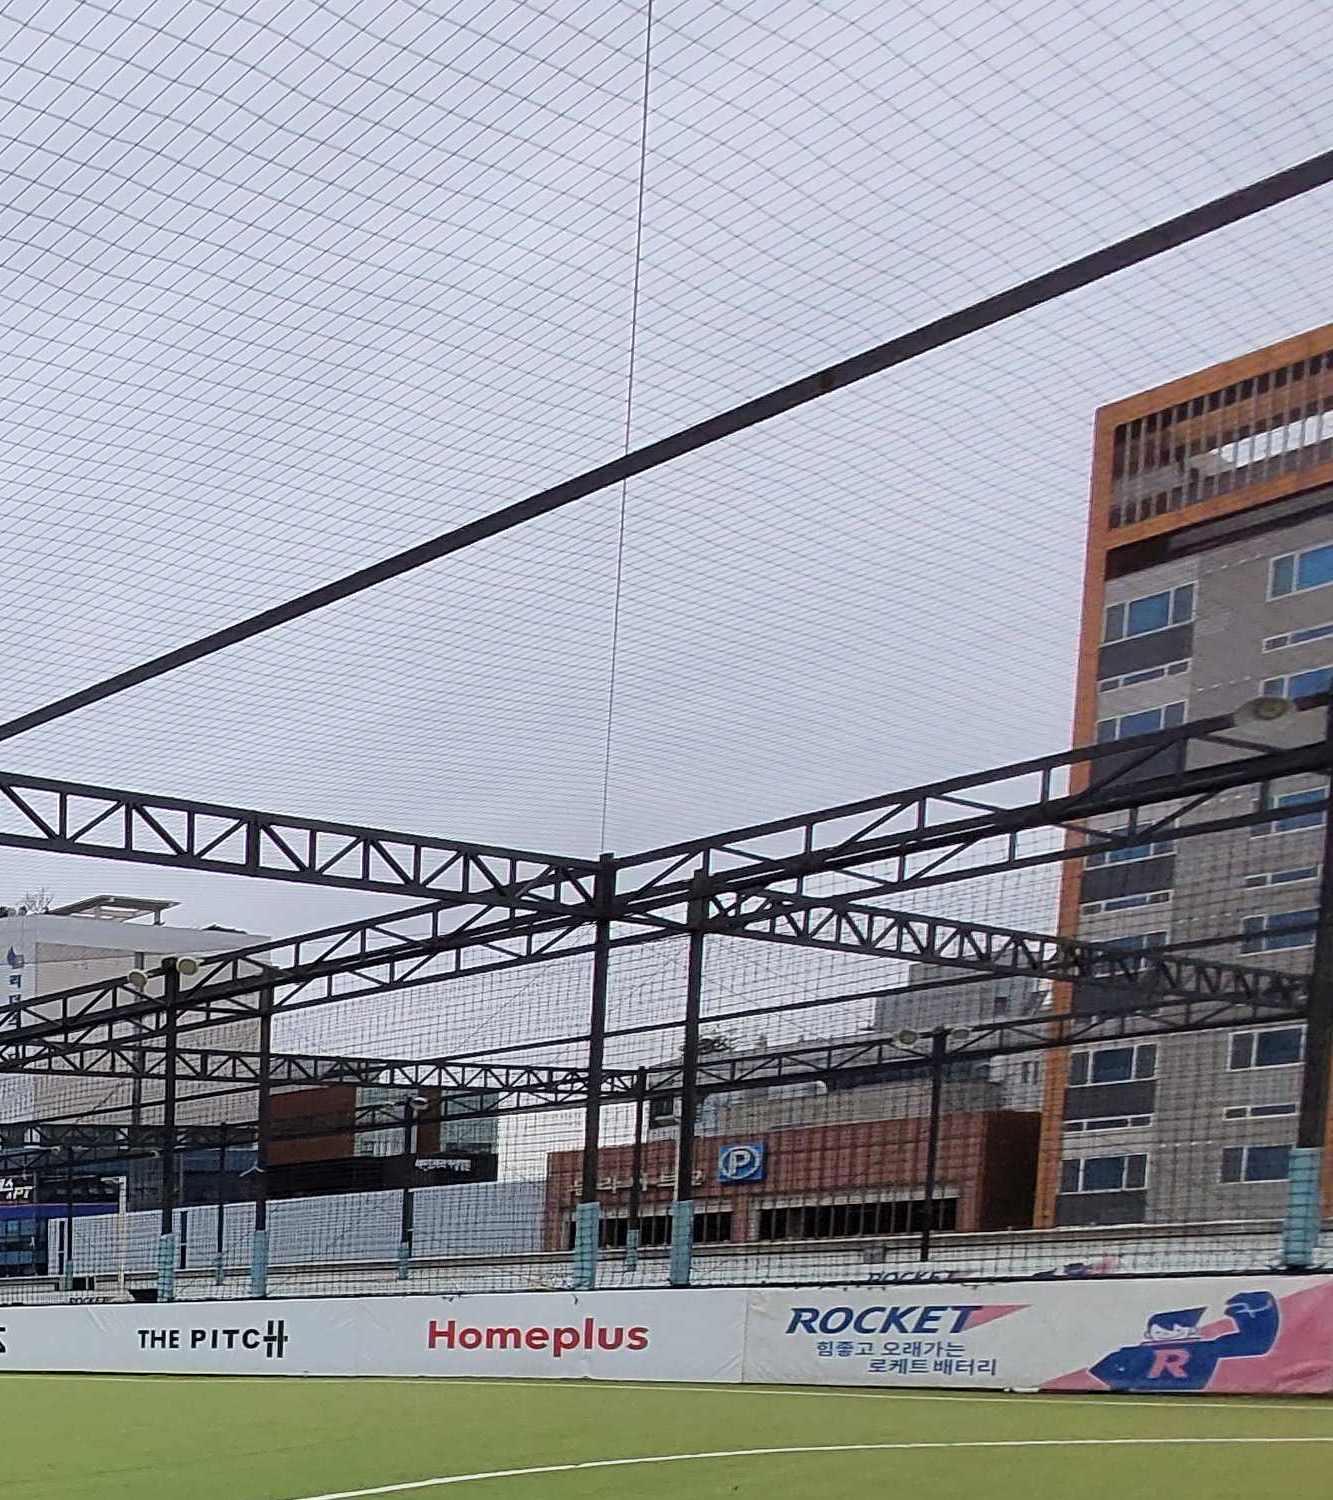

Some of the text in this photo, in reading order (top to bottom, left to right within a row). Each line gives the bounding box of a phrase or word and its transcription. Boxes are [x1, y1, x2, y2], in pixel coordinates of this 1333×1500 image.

[785, 1305, 984, 1335] ROCKET
[137, 1319, 289, 1359] THE PITCH
[427, 1317, 650, 1358] Homeplus
[816, 1340, 966, 1358] 힘좋고 오래가는
[868, 1358, 997, 1376] 로케트 배터리
[1147, 1349, 1190, 1380] R
